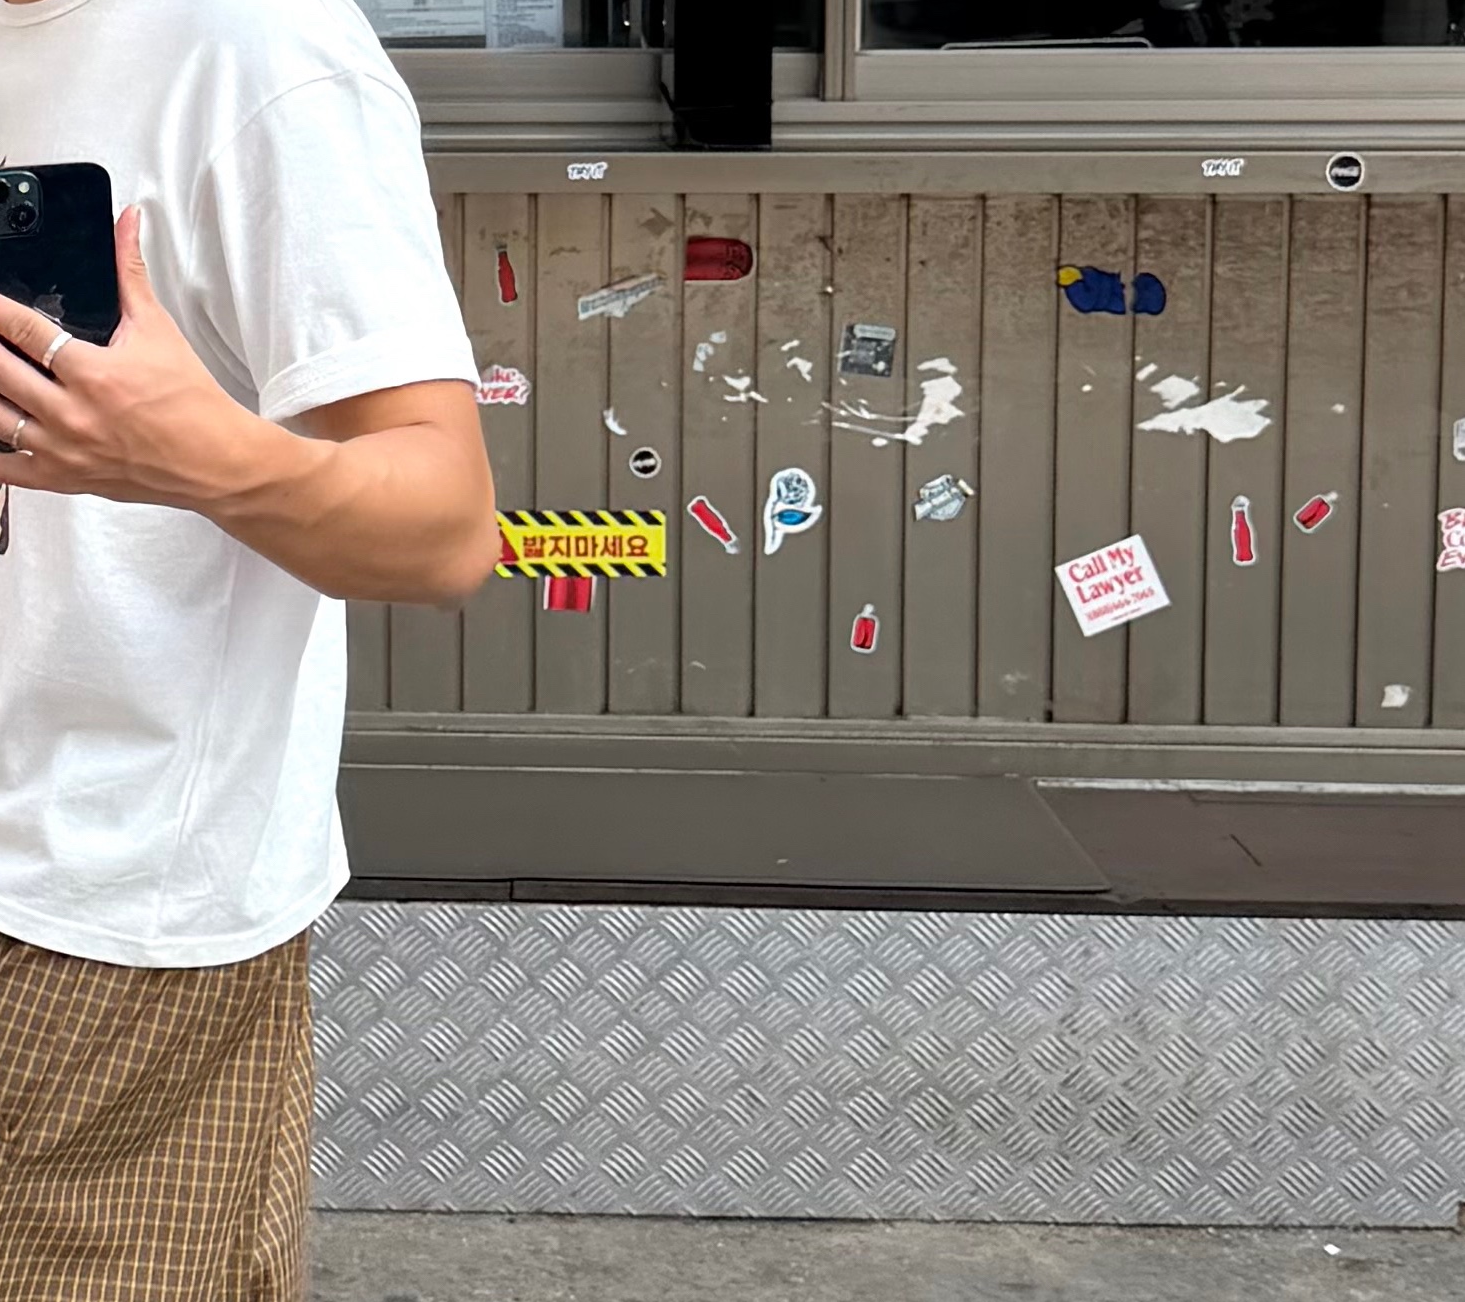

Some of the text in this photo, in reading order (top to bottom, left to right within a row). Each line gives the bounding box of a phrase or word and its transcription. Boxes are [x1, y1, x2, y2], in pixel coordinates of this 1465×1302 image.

[522, 534, 650, 558] 밟지마세요
[1068, 545, 1135, 583] Call My
[1075, 565, 1144, 604] Lawyer
